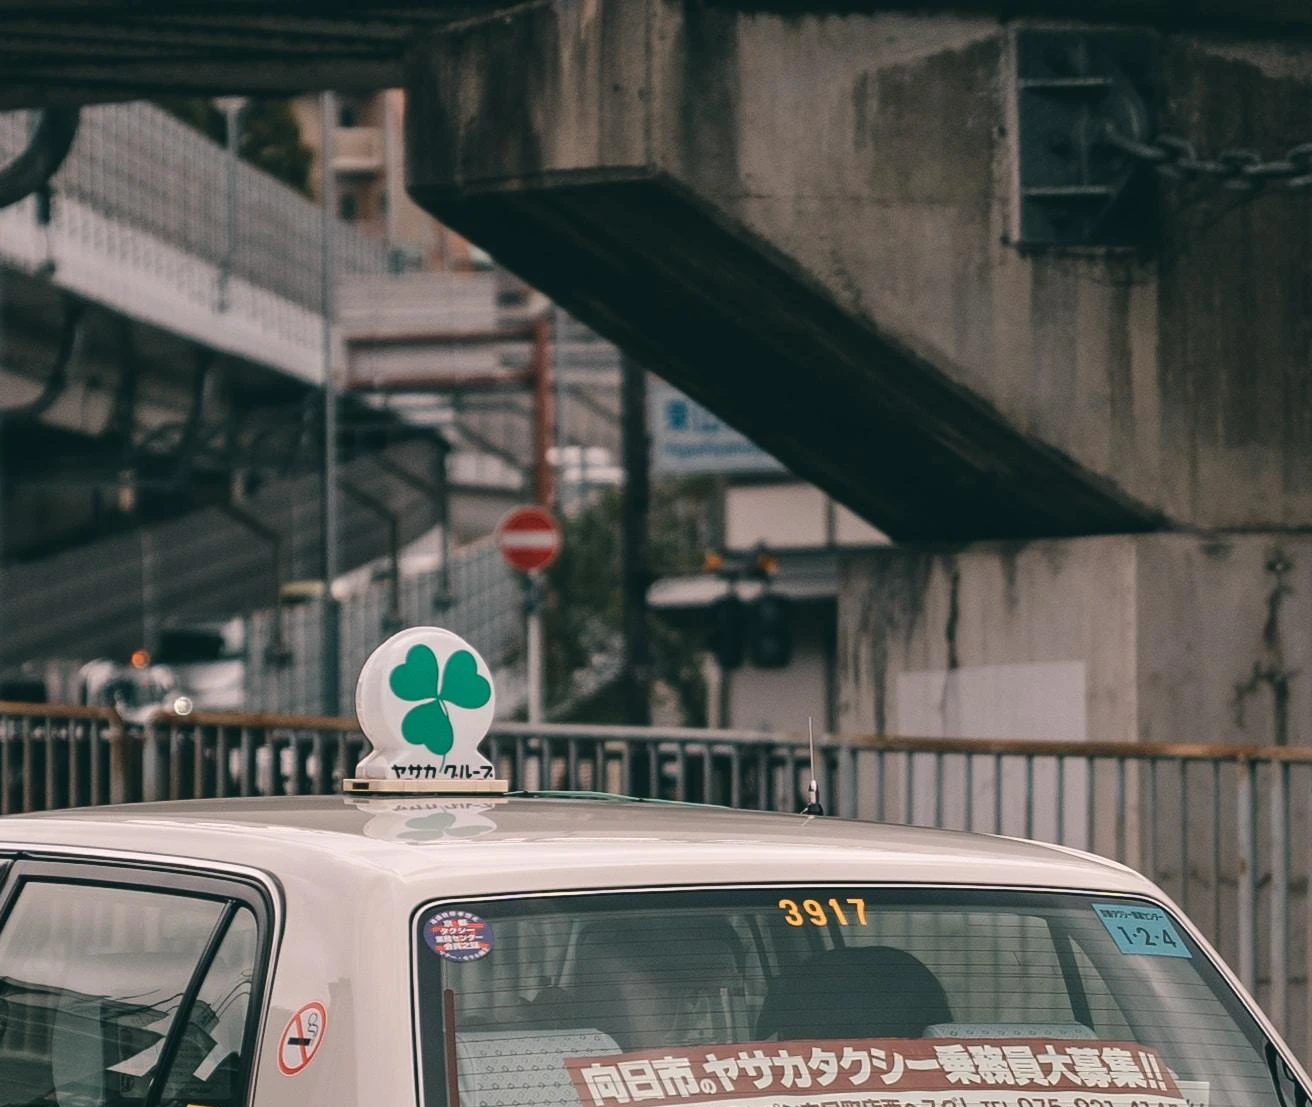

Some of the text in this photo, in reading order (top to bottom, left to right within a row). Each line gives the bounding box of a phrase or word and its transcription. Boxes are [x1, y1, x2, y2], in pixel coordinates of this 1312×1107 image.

[392, 764, 494, 779] ヤサカ グループ
[778, 898, 867, 926] 3917
[580, 1044, 1167, 1107] 向日市のヤサカタクシー乗務員大募集!!
